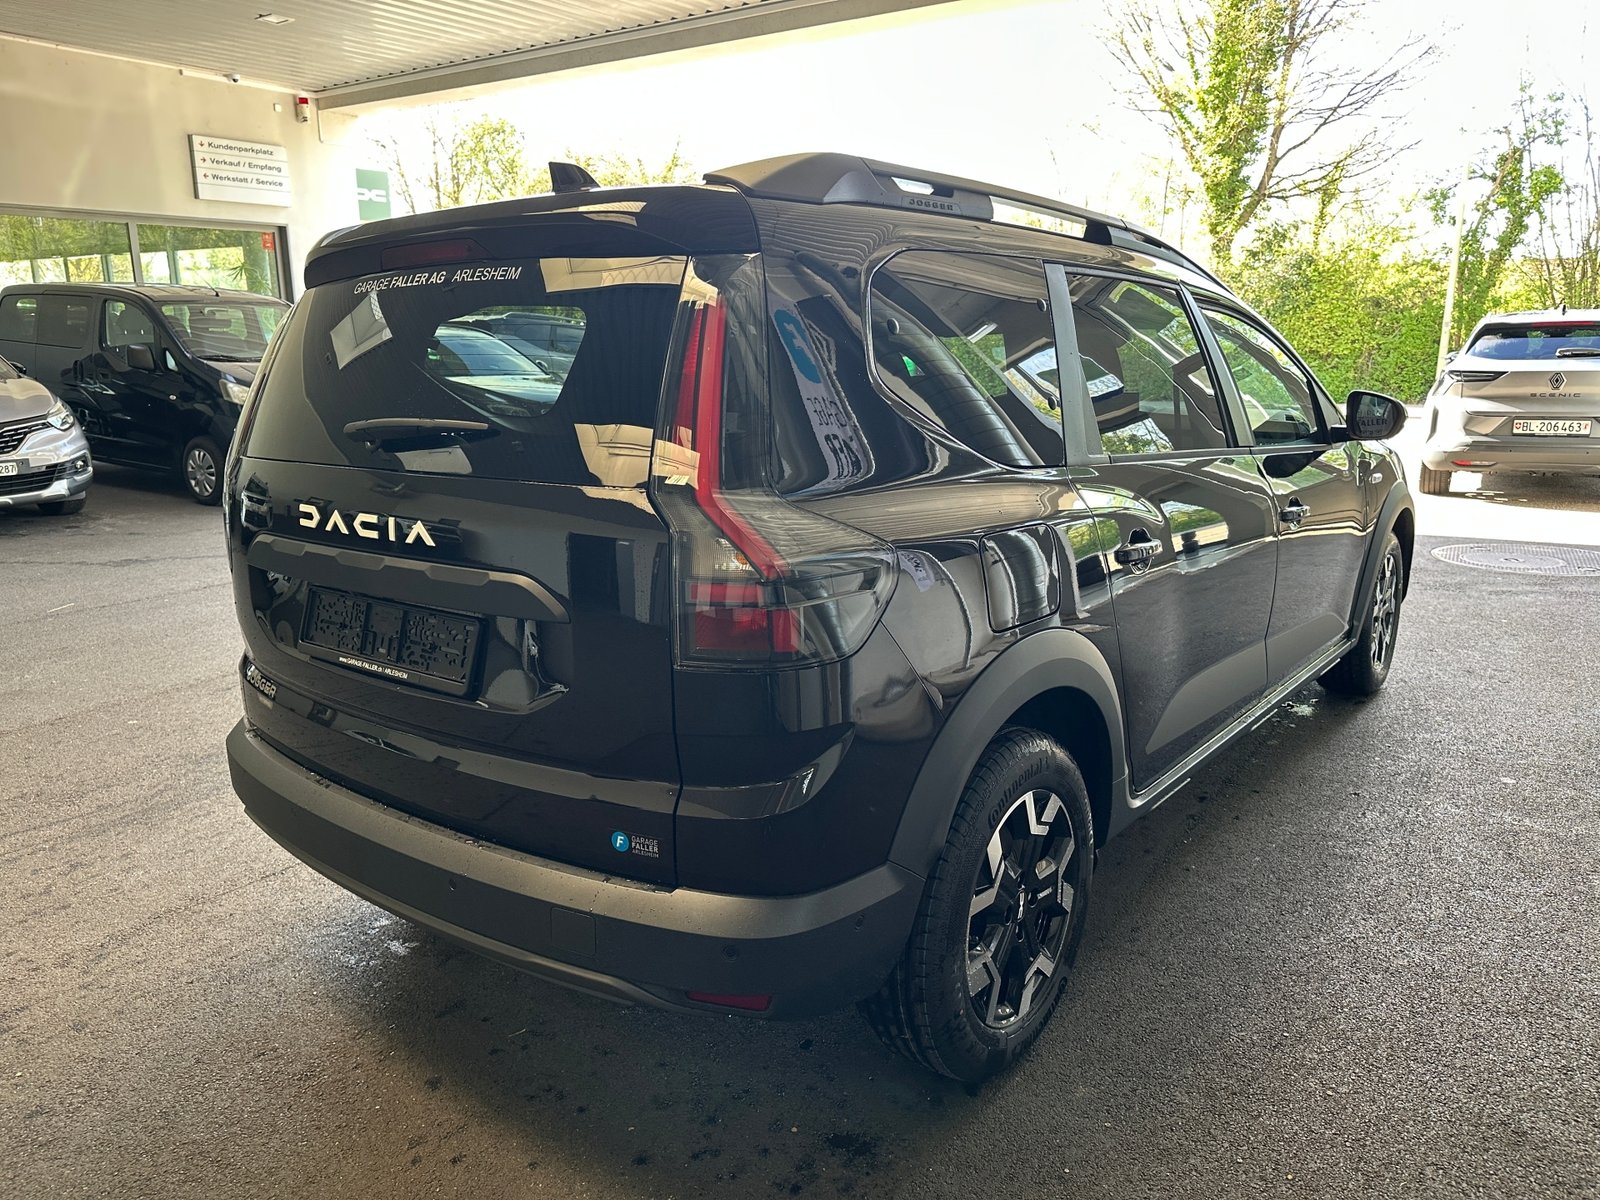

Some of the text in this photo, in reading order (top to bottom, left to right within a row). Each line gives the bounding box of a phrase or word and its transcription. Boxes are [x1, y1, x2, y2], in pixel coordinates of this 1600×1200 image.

[207, 141, 274, 156] Kundenparkplatz
[209, 157, 241, 168] Verkauf
[248, 162, 282, 173] Empfang
[211, 173, 248, 184] Werkstatt
[255, 178, 283, 188] Service
[353, 266, 523, 295] GARAGE FALLER AG ARLESHEIM
[299, 503, 436, 547] DACIA
[631, 835, 659, 847] GARAGE
[631, 842, 659, 854] FALLER
